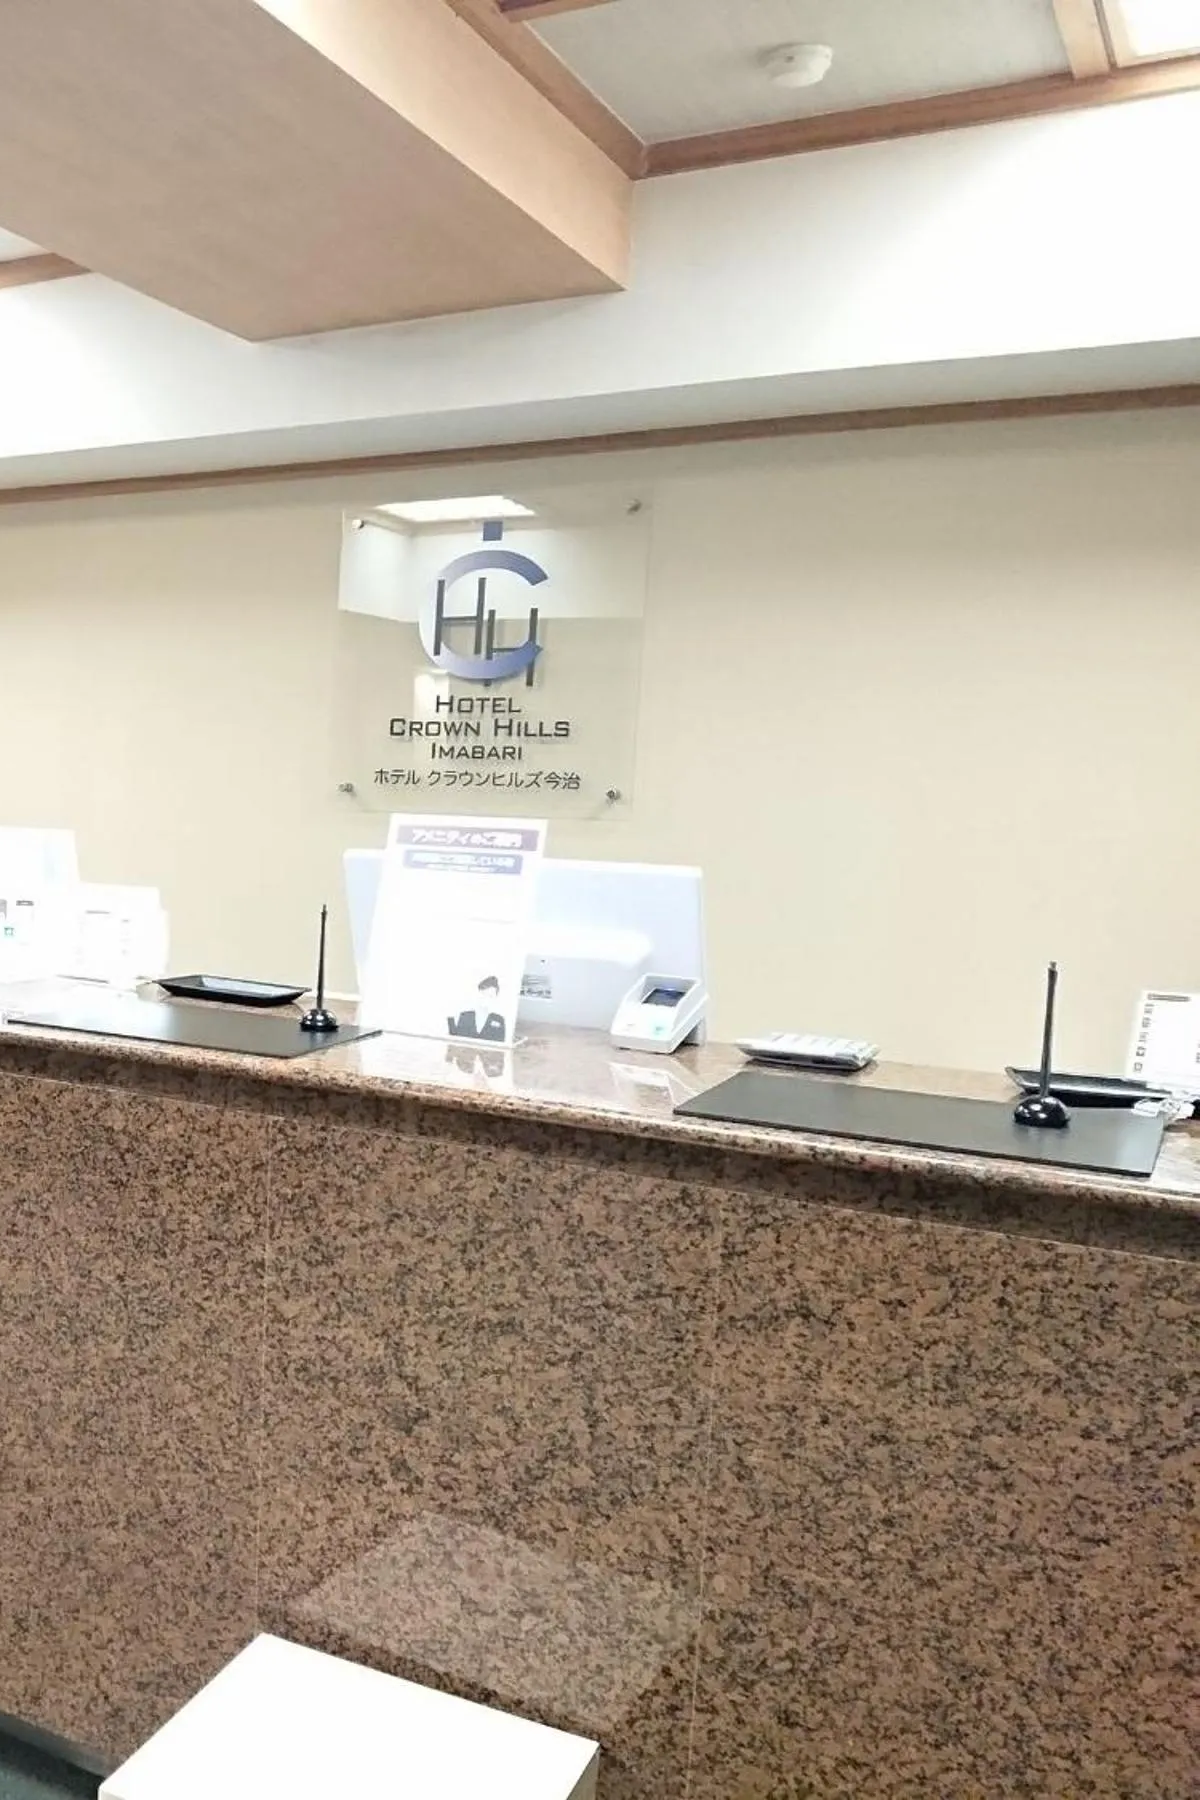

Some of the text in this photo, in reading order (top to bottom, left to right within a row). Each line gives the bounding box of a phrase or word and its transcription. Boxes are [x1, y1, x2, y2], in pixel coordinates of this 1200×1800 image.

[435, 695, 522, 714] HOTEL
[389, 718, 571, 738] CROWN HILLS
[431, 742, 523, 761] IMABARI
[373, 768, 582, 790] ホテル クラウンヒルズ今治
